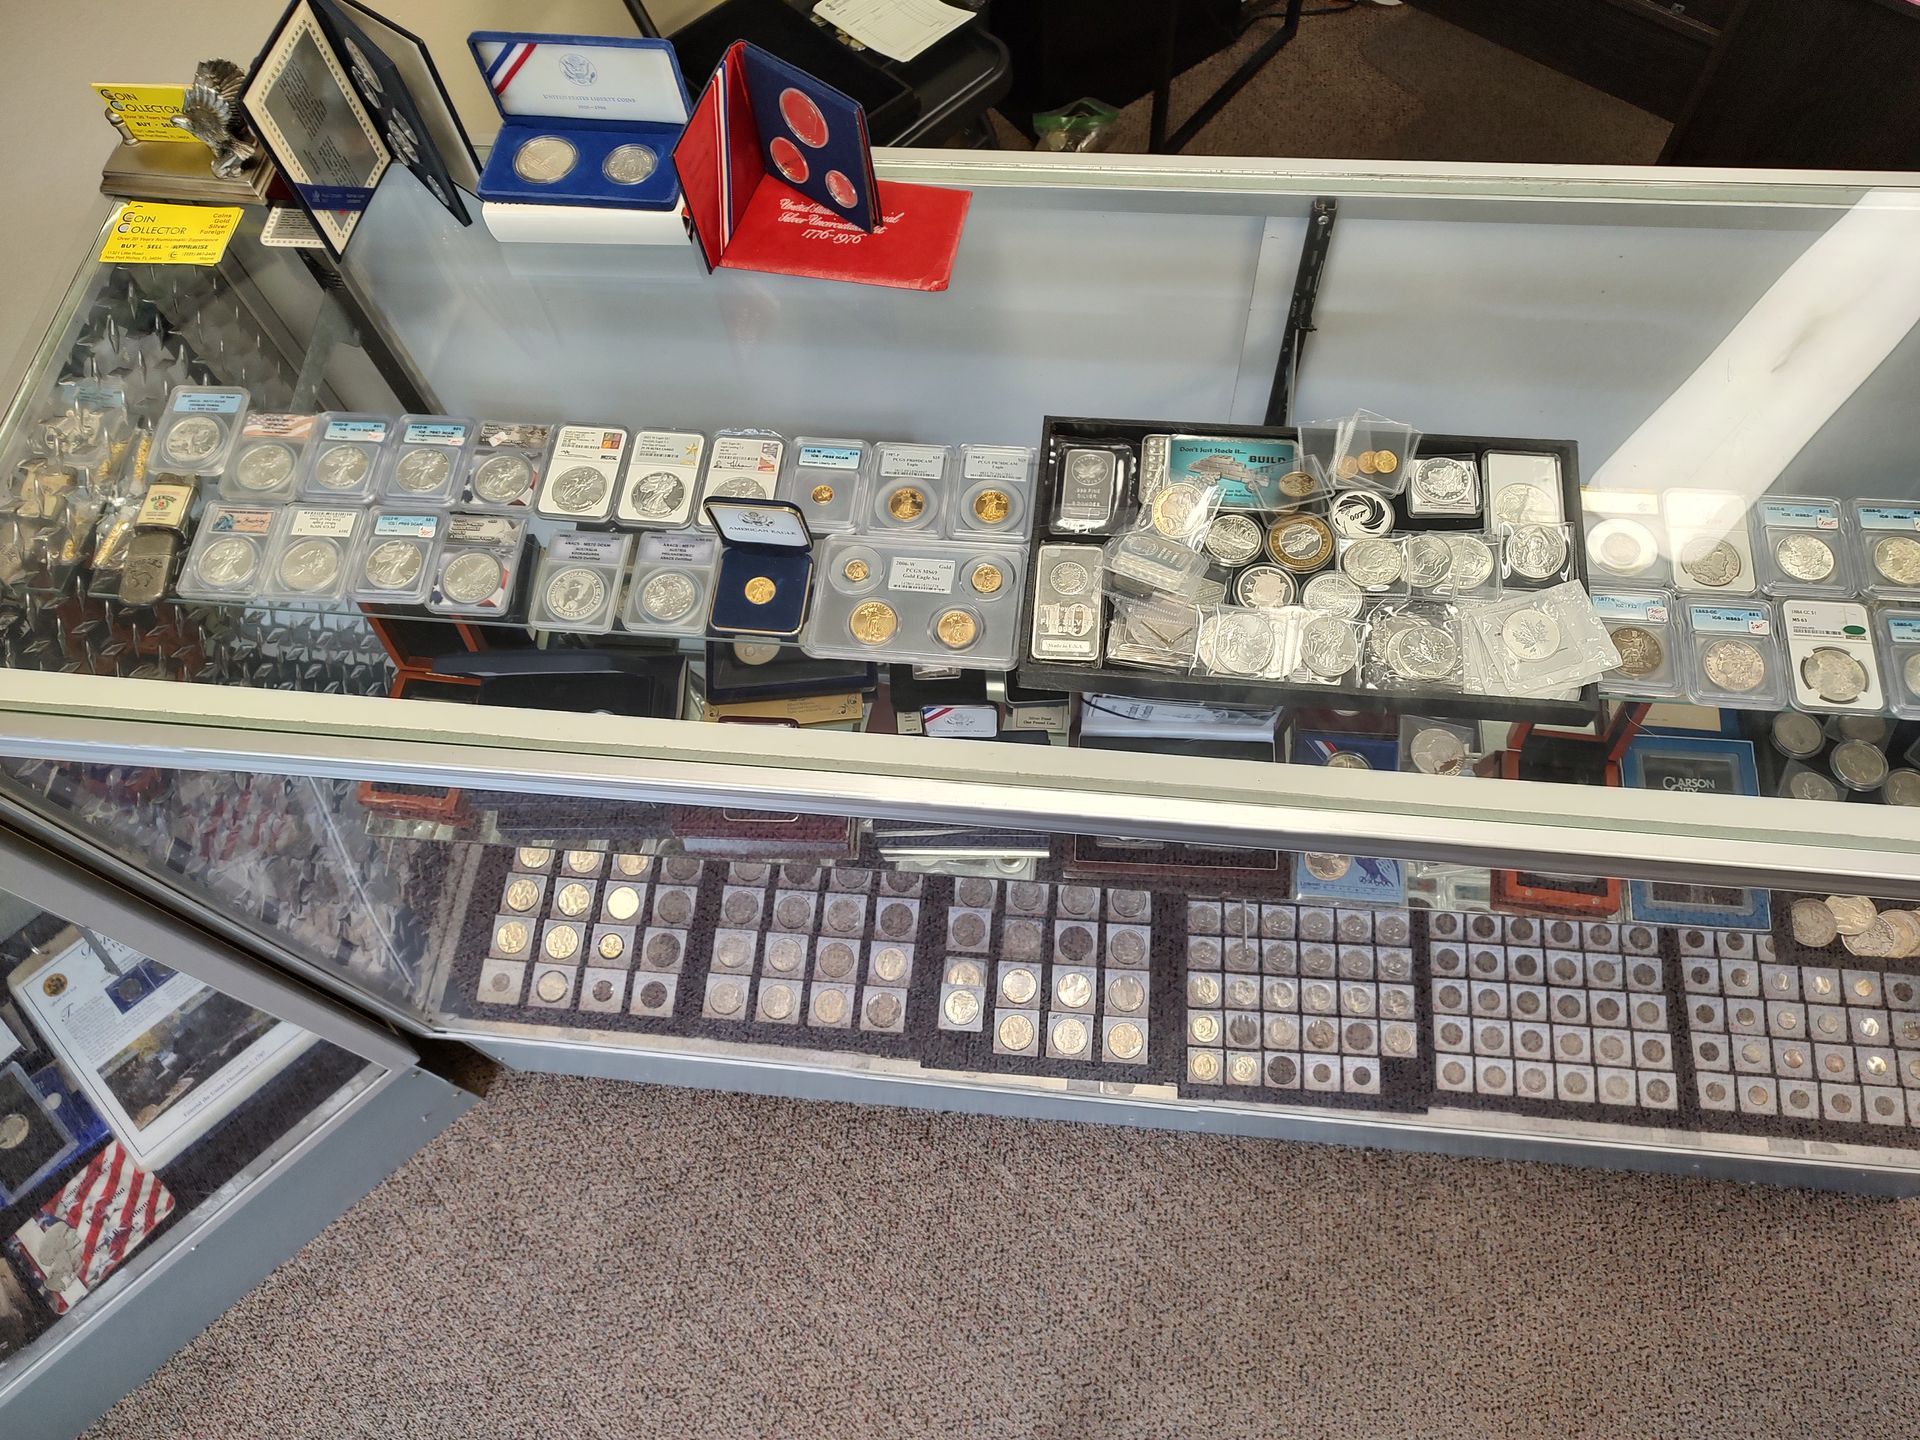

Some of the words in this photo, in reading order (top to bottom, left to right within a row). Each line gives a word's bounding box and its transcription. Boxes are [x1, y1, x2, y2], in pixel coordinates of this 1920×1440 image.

[100, 88, 138, 100] COIN
[110, 100, 182, 113] COLLECTOR
[122, 212, 156, 223] COIN
[118, 223, 187, 235] COLLECTOR
[802, 229, 867, 244] 1776-1976
[1350, 508, 1367, 521] 007
[1040, 602, 1094, 637] 10
[1663, 776, 1716, 791] CARSON
